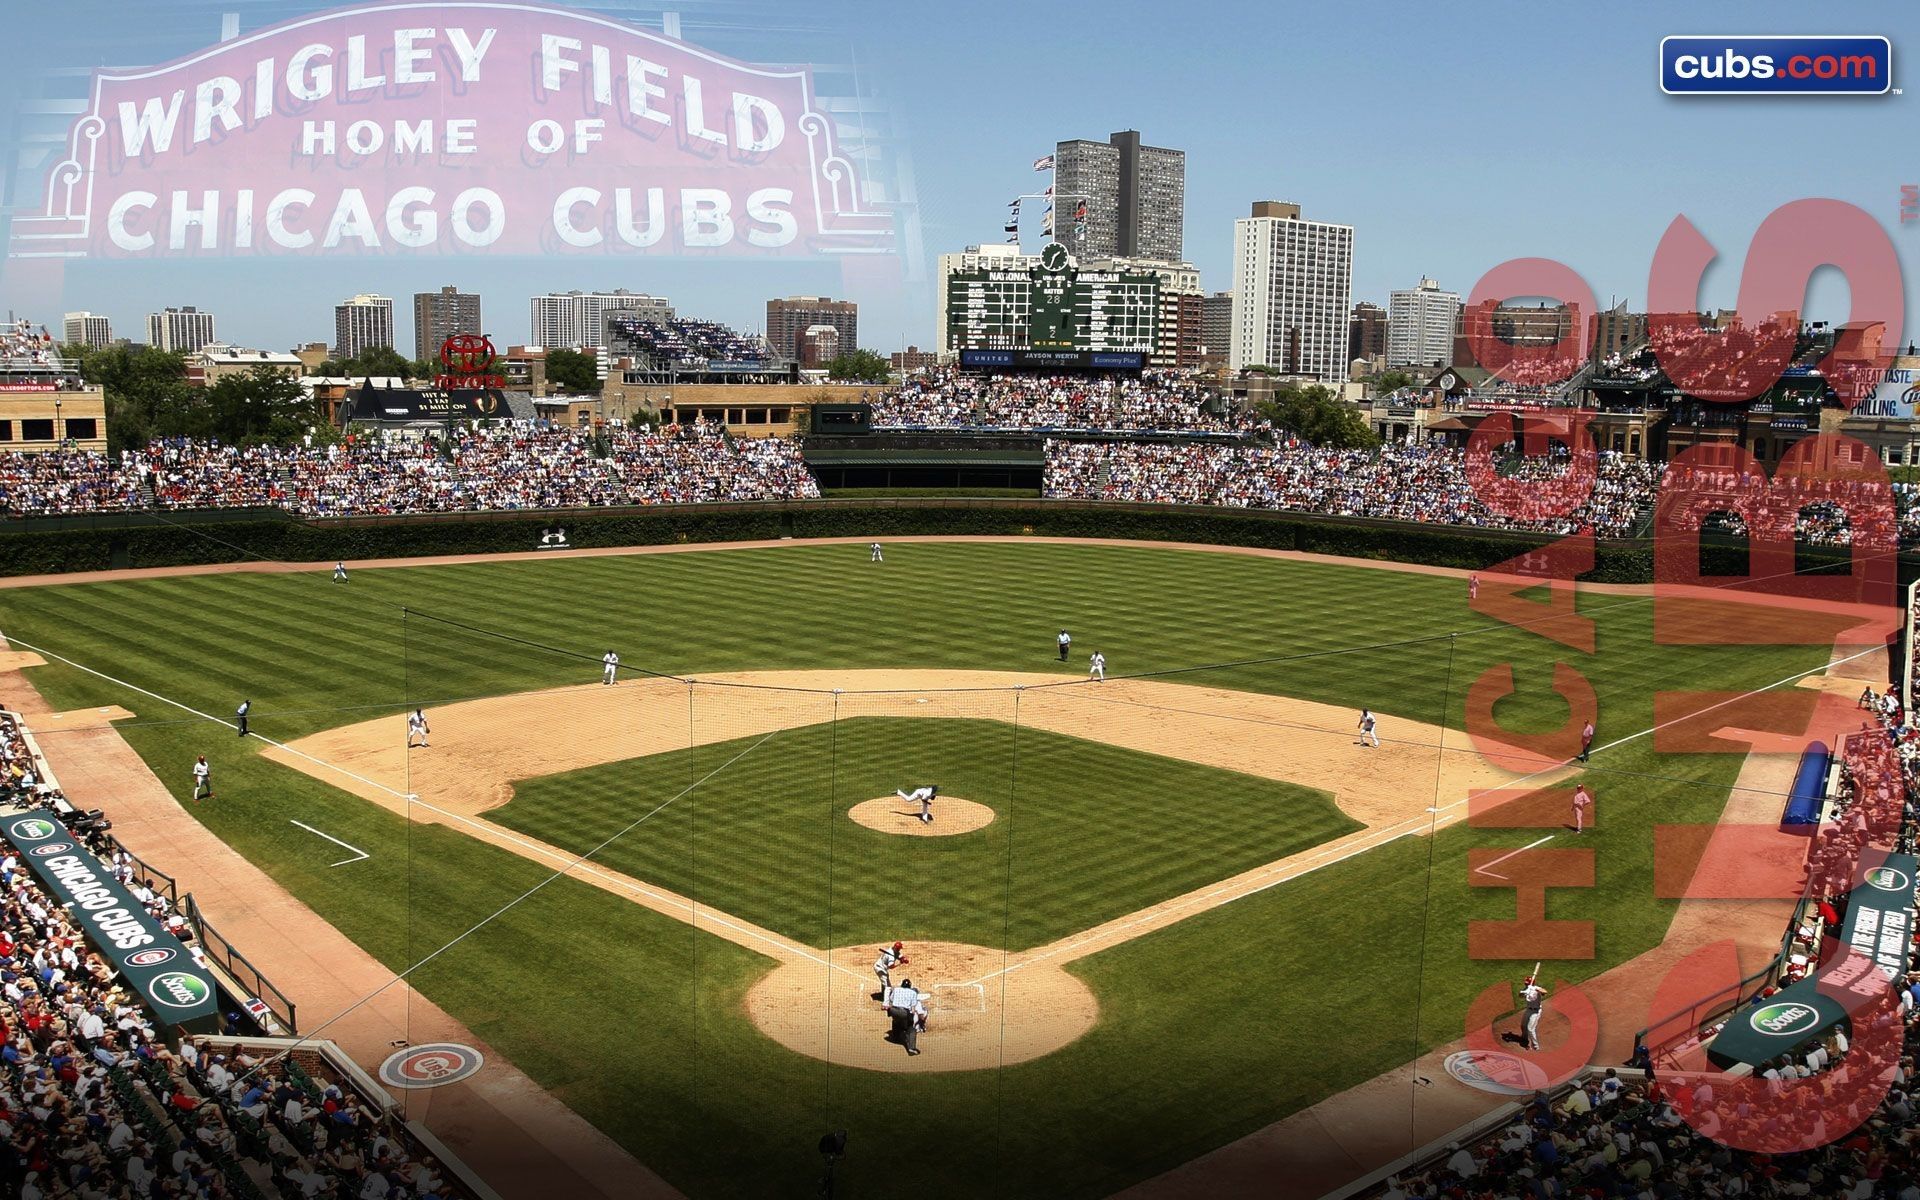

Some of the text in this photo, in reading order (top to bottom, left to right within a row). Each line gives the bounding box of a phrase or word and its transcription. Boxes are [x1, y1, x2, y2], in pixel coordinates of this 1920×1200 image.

[989, 271, 1032, 281] NATIONAL
[1075, 273, 1120, 282] AMERICAN
[1046, 294, 1061, 304] 28
[1049, 329, 1056, 339] 2
[1094, 356, 1122, 364] Economy
[1854, 368, 1882, 383] GREAT
[433, 374, 507, 390] TOYOTA
[1852, 383, 1878, 399] LESS
[44, 855, 120, 910] CHICAGO
[92, 908, 155, 950] CUBS
